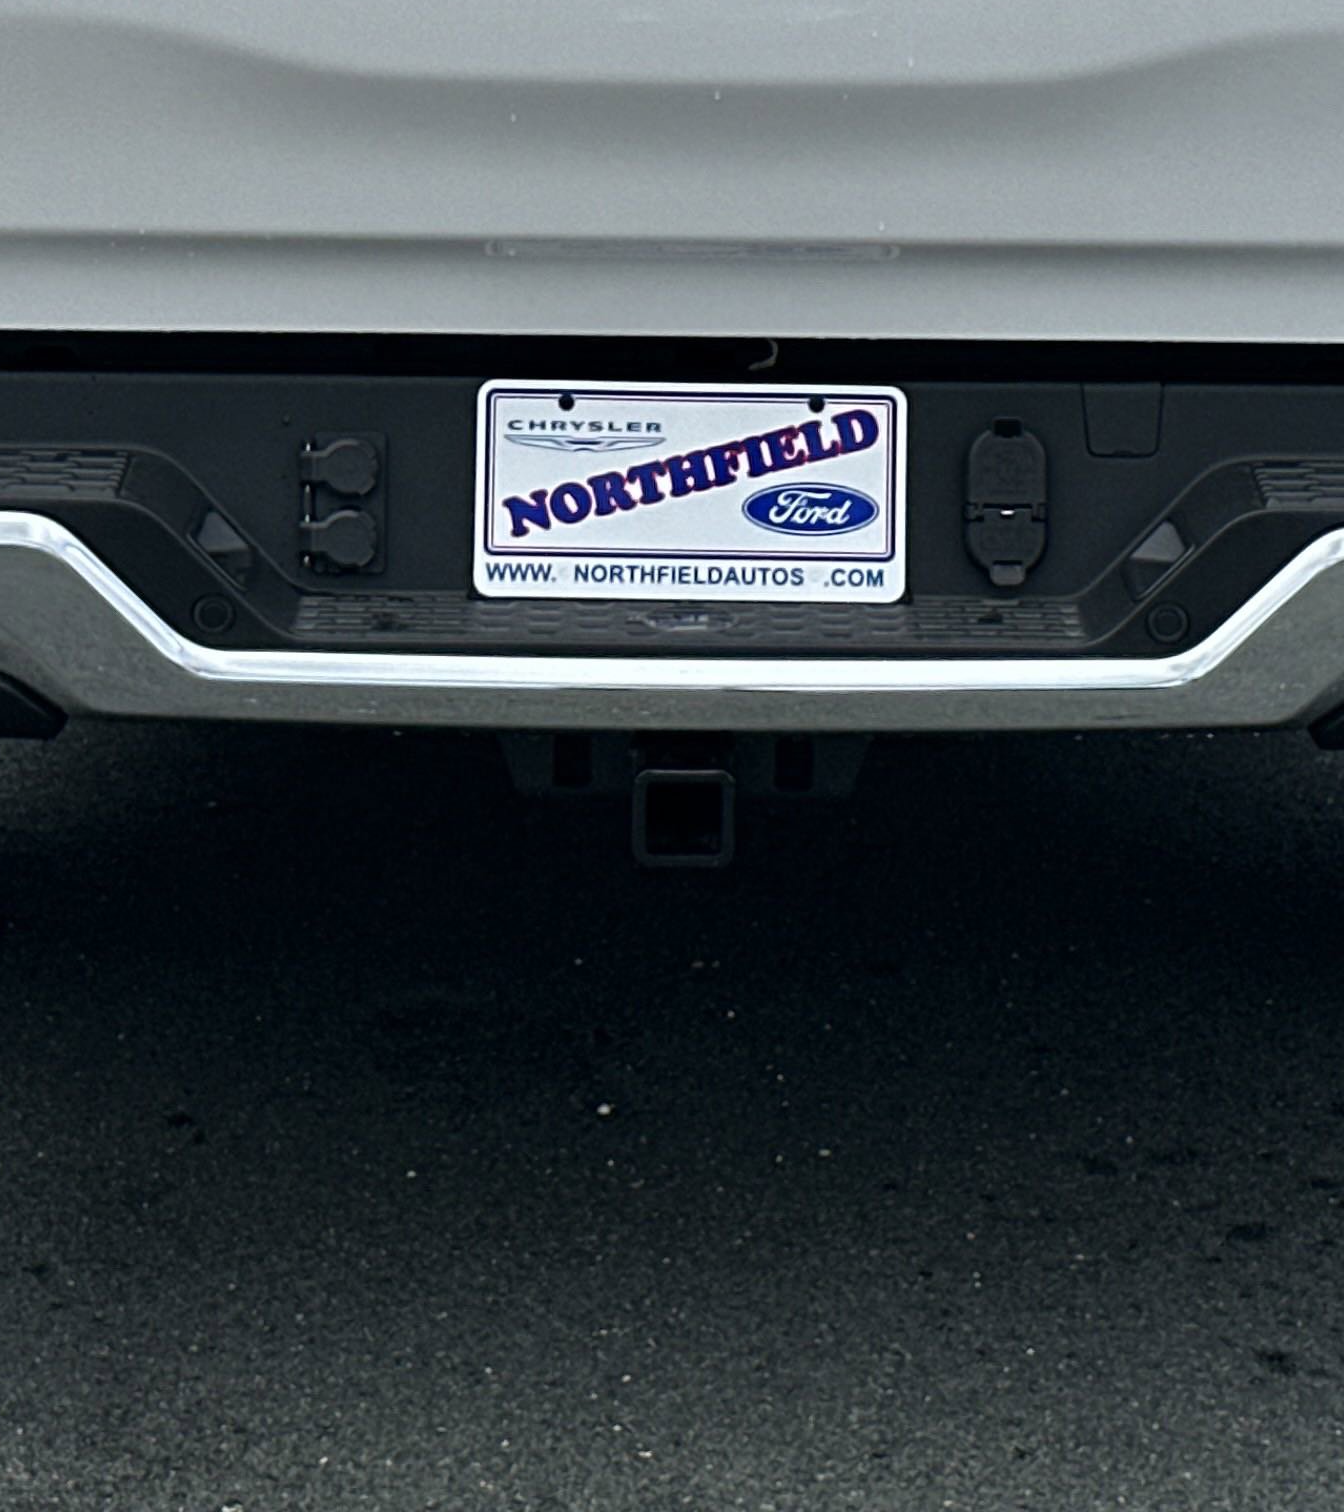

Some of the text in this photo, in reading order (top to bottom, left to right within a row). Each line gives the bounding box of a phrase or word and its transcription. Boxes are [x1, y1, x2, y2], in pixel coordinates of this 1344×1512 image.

[507, 419, 663, 433] CHRYSLER
[502, 409, 880, 538] NORTHFIELD
[768, 490, 851, 526] Ford
[573, 564, 805, 587] NORTHFIELDAUTOS
